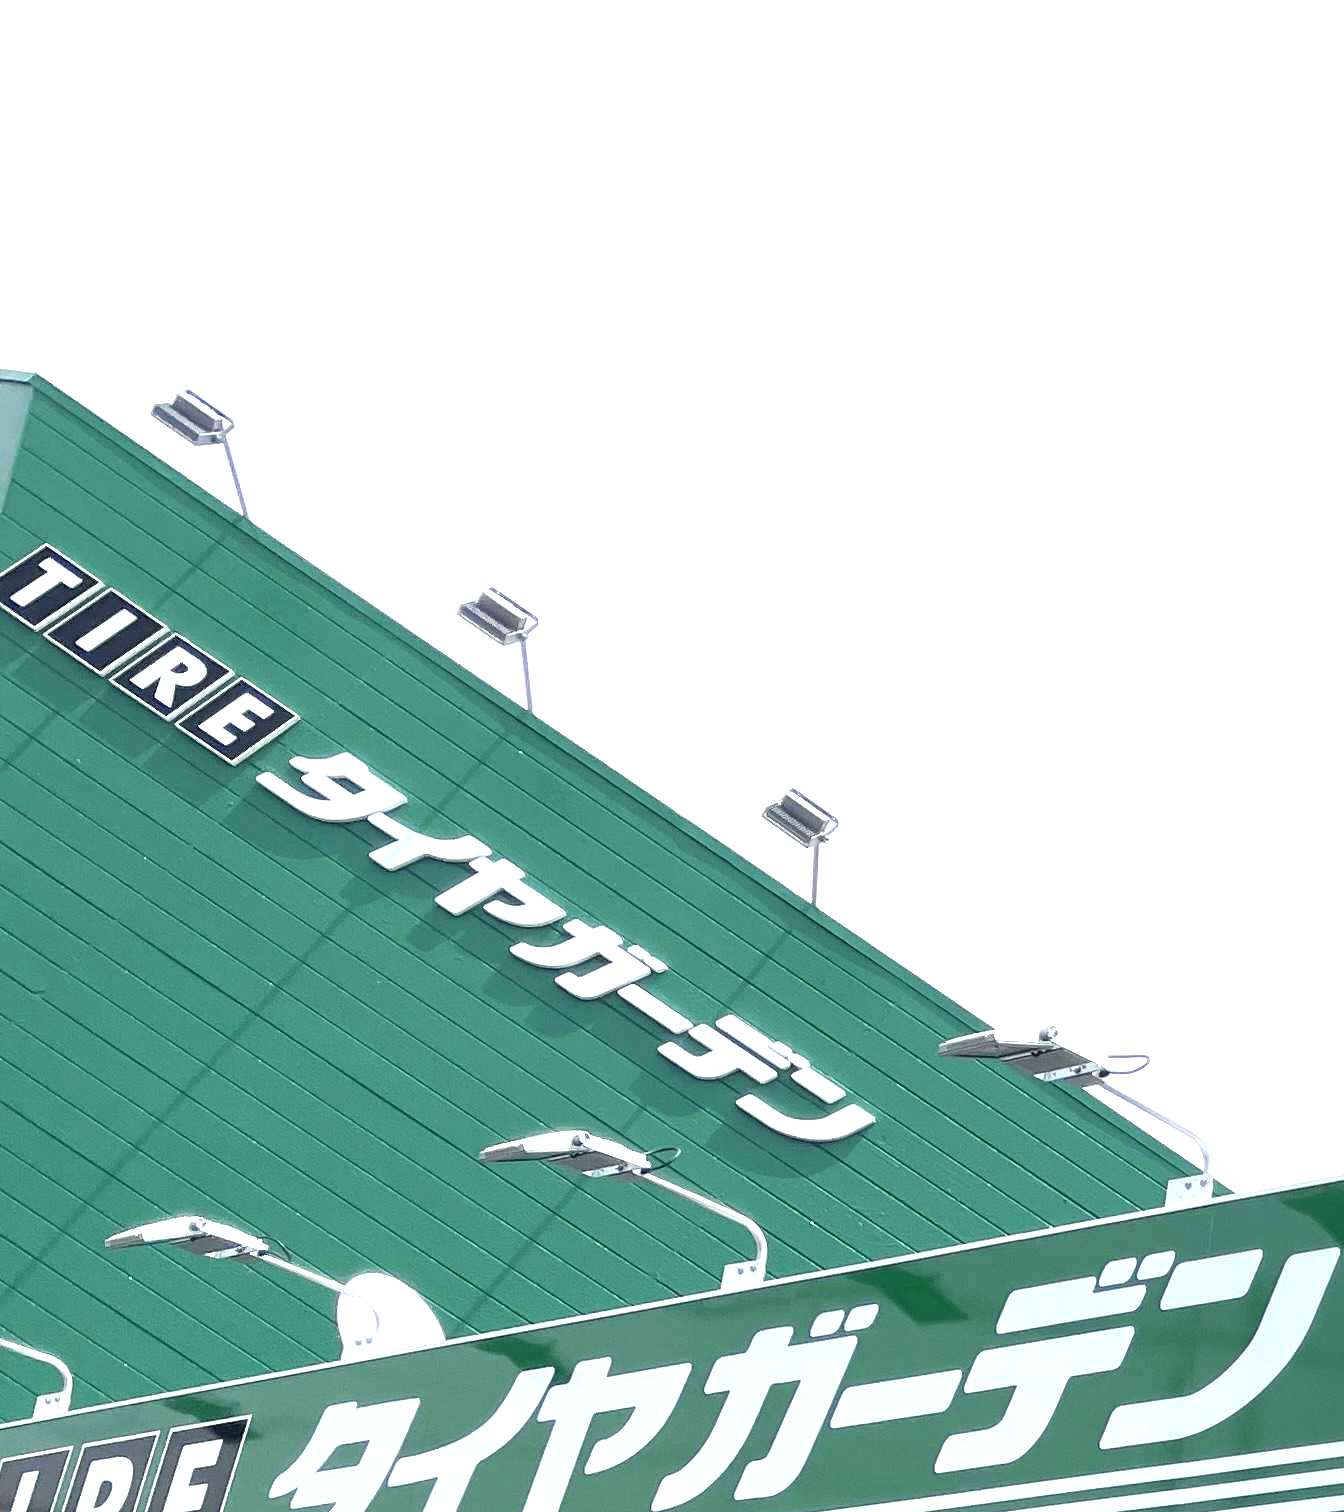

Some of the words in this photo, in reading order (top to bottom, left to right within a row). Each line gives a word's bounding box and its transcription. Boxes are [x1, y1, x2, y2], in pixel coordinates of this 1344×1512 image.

[9, 556, 276, 748] TIRE
[255, 751, 877, 1143] タイヤガーデン
